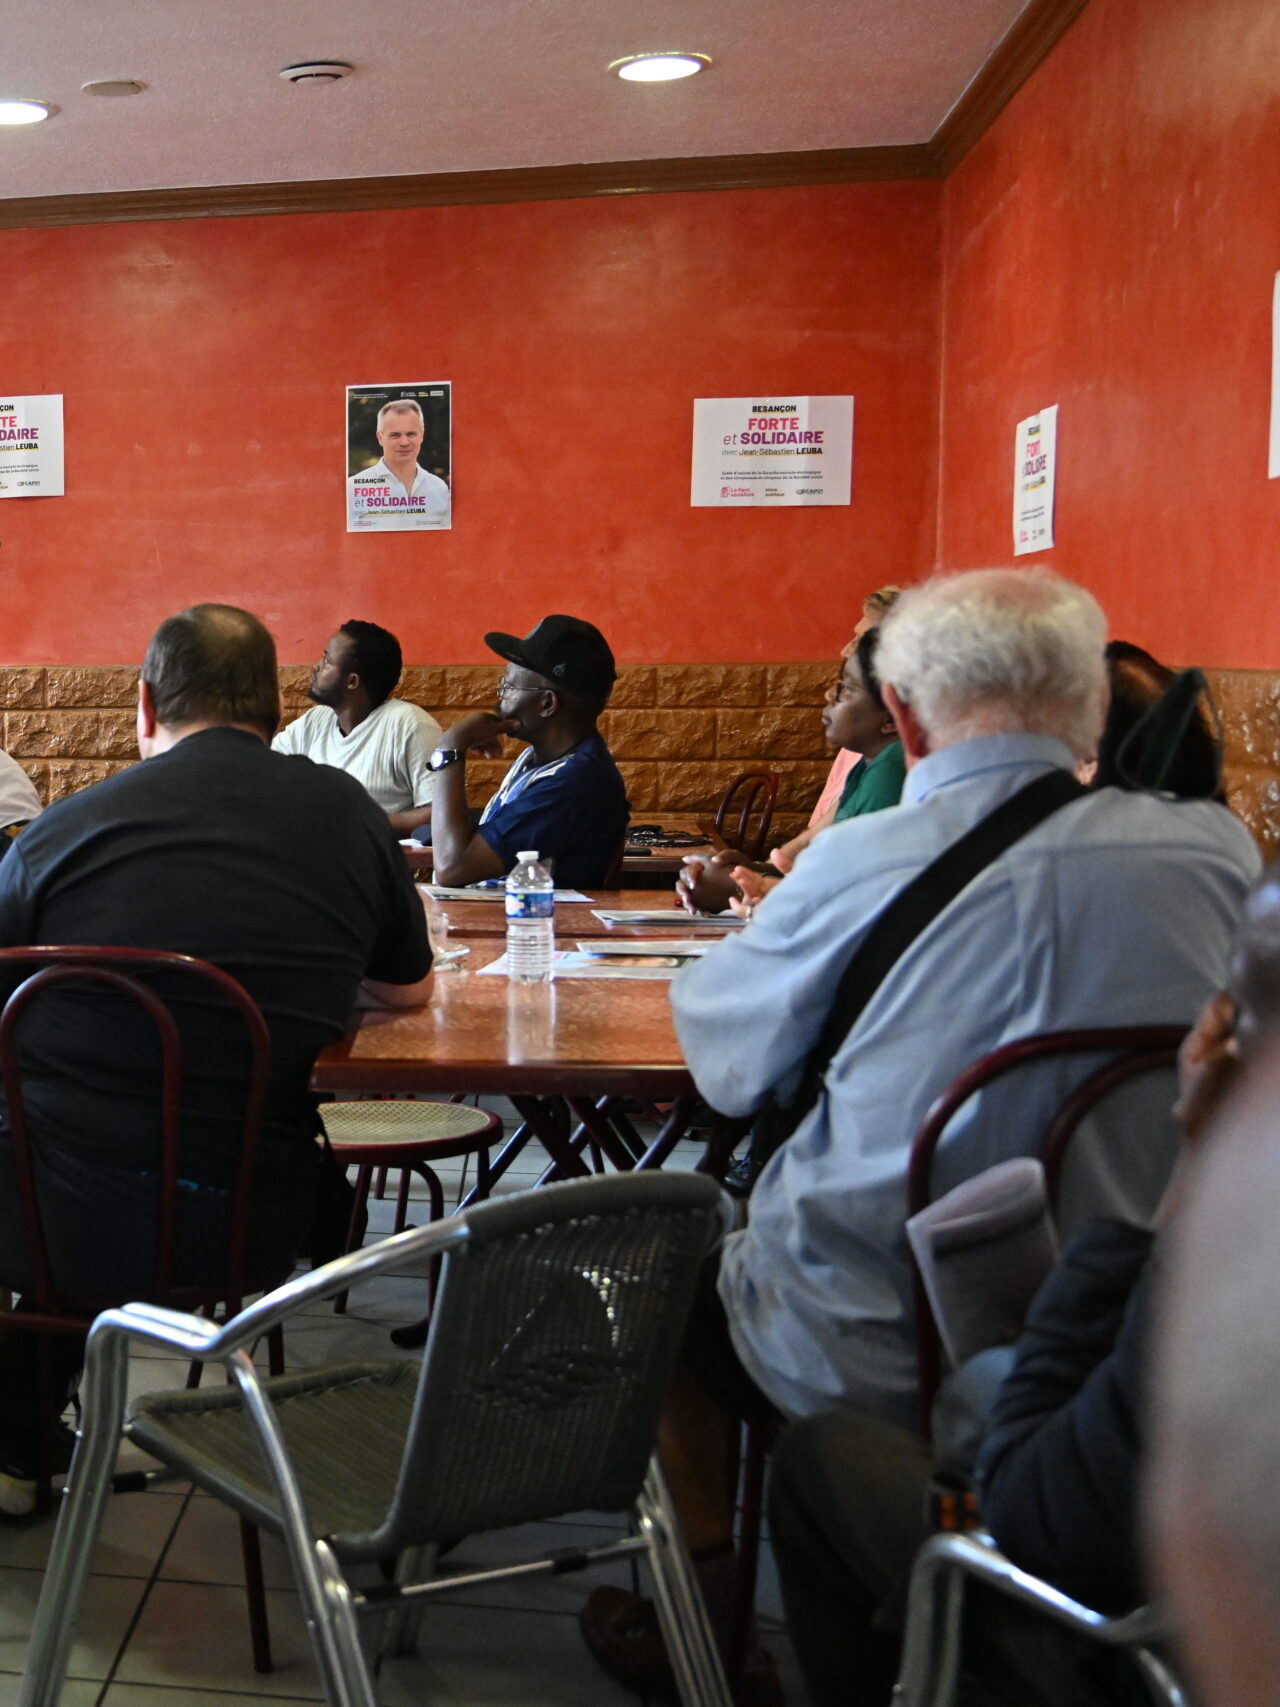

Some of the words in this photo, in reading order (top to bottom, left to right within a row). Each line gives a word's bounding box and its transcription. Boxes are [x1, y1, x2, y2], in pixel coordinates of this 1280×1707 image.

[752, 405, 796, 413] BESANÇON
[748, 417, 800, 430] FORTE
[723, 433, 738, 445] et
[740, 431, 824, 445] SOLIDAIRE
[739, 447, 795, 456] Jean-Sébastien
[354, 487, 391, 497] FORTE
[354, 498, 365, 507] et
[366, 496, 426, 507] SOLIDAIRE
